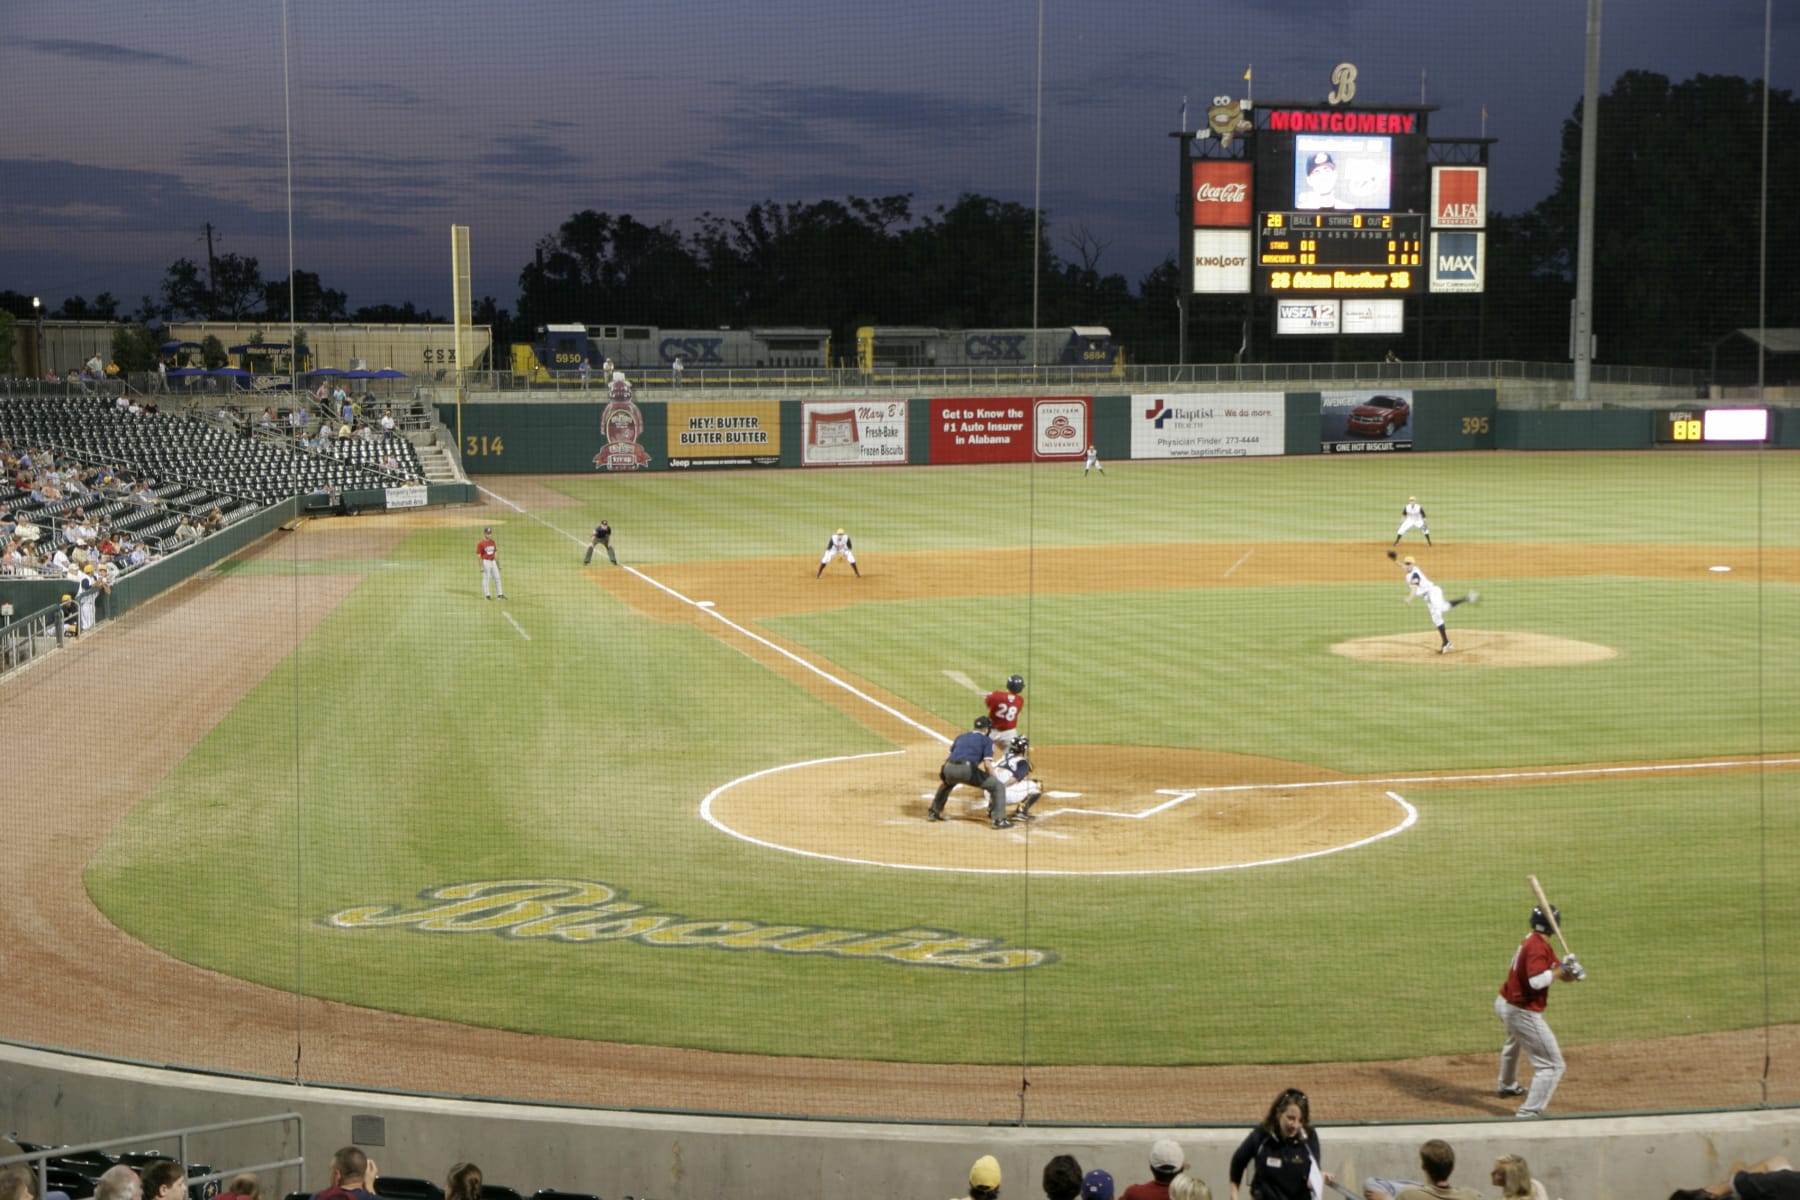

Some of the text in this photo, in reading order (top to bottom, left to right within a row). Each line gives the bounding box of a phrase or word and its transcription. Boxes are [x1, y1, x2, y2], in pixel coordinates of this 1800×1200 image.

[1328, 62, 1358, 105] B
[1270, 111, 1414, 134] MONTGOMERY
[1442, 203, 1477, 218] ALFA
[1267, 214, 1283, 228] 28
[1293, 214, 1391, 228] BALL 1 STRIKE 0 OUT 2
[1262, 228, 1287, 236] AT BAT
[1404, 241, 1408, 252] 1
[1414, 241, 1419, 252] 1
[1196, 254, 1246, 268] KNOLOGY
[1262, 254, 1296, 264] BISCUITS
[1440, 256, 1478, 280] MAX
[1280, 306, 1314, 319] WSFA
[1314, 304, 1335, 319] 12
[659, 337, 723, 363] CSX
[965, 334, 1026, 360] CSX
[424, 349, 456, 361] CSX
[556, 353, 581, 364] 5950
[858, 406, 884, 420] Mary
[942, 408, 1024, 420] Get to Know the
[1174, 408, 1214, 422] Baptist
[1670, 412, 1692, 421] MPH
[689, 416, 759, 430] HEY! BUTTER
[944, 422, 1024, 432] #1 Auto Insurer
[1462, 417, 1488, 434] 395
[1674, 420, 1701, 440] 88
[680, 430, 768, 444] BUTTER BUTTER
[866, 426, 899, 438] Fresh-Bake
[467, 436, 504, 456] 314
[956, 435, 1010, 444] in Alabama
[1158, 438, 1195, 448] Physician
[1197, 437, 1222, 445] Finder
[860, 444, 904, 456] Frozen Biscuits
[1170, 448, 1247, 456] www.baptistfirst.org
[1336, 443, 1350, 452] ONE
[1352, 443, 1365, 451] HOT
[670, 458, 690, 468] Jeep
[996, 704, 1018, 721] 28
[323, 877, 1061, 972] Biscuits
